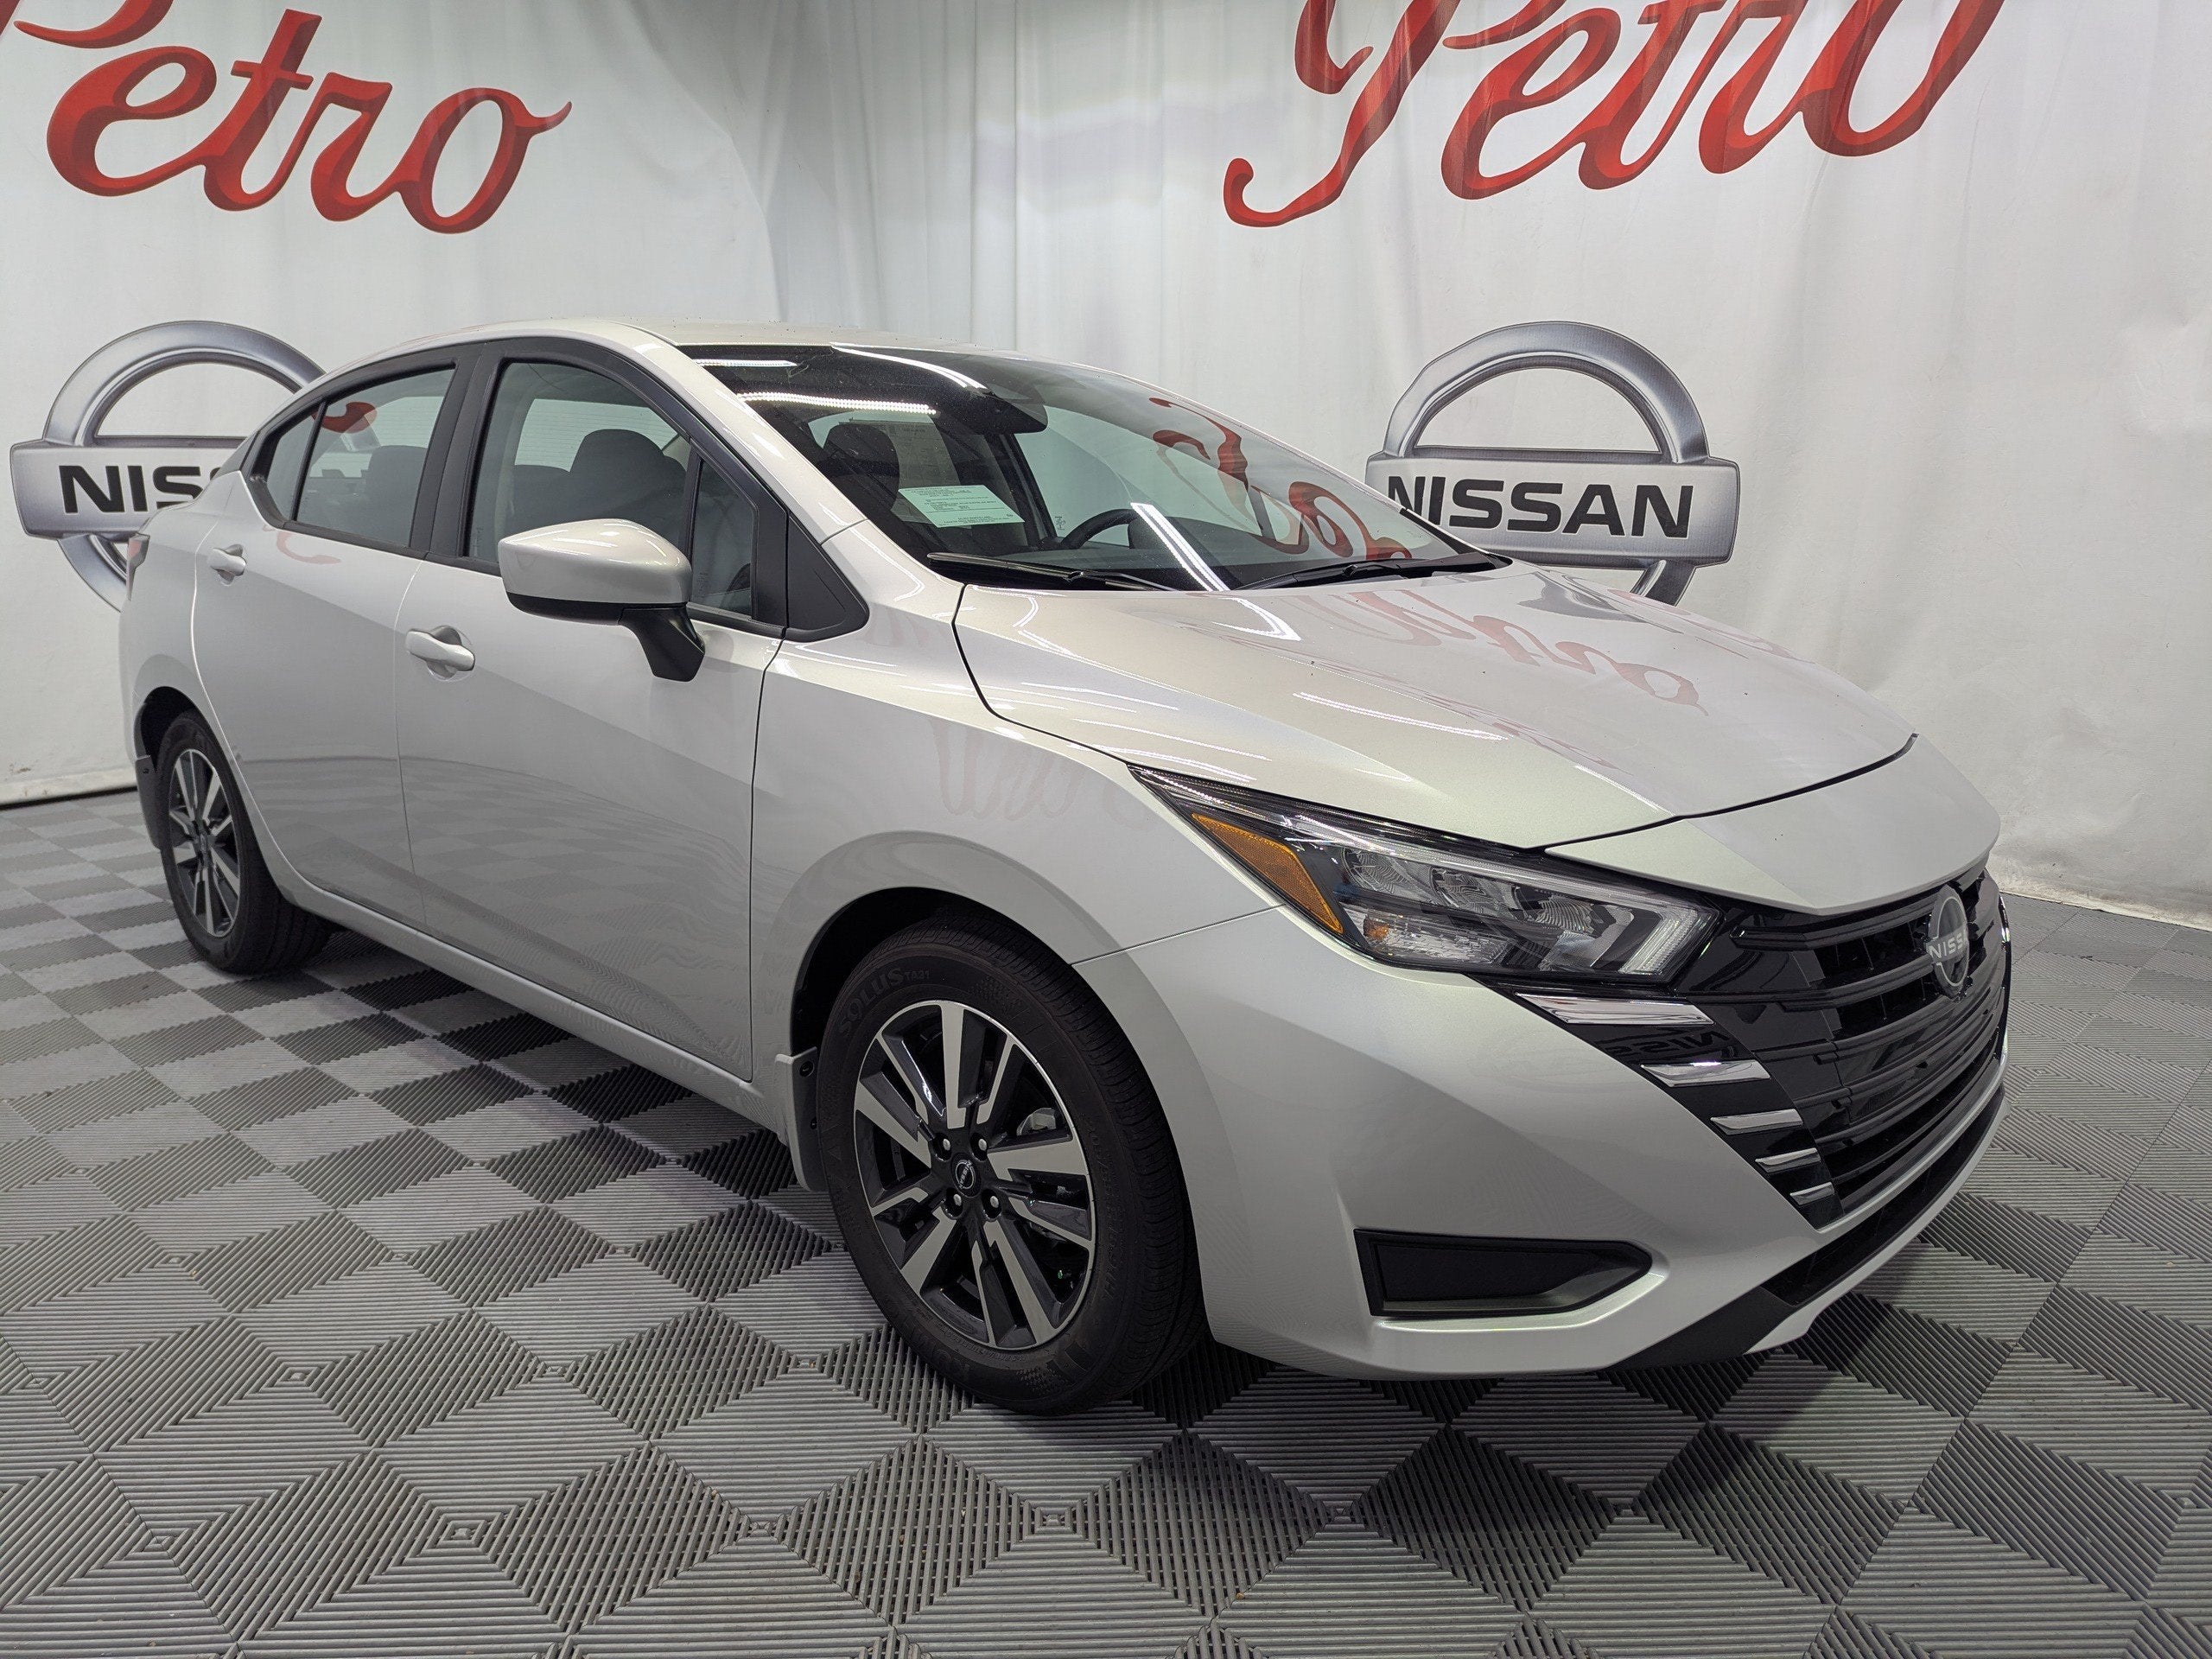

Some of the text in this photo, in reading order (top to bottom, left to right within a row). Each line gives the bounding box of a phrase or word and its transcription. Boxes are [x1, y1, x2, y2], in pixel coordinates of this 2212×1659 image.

[59, 465, 221, 514] NIS
[1388, 476, 1694, 538] NISSAN
[839, 967, 904, 1036] SOLUS
